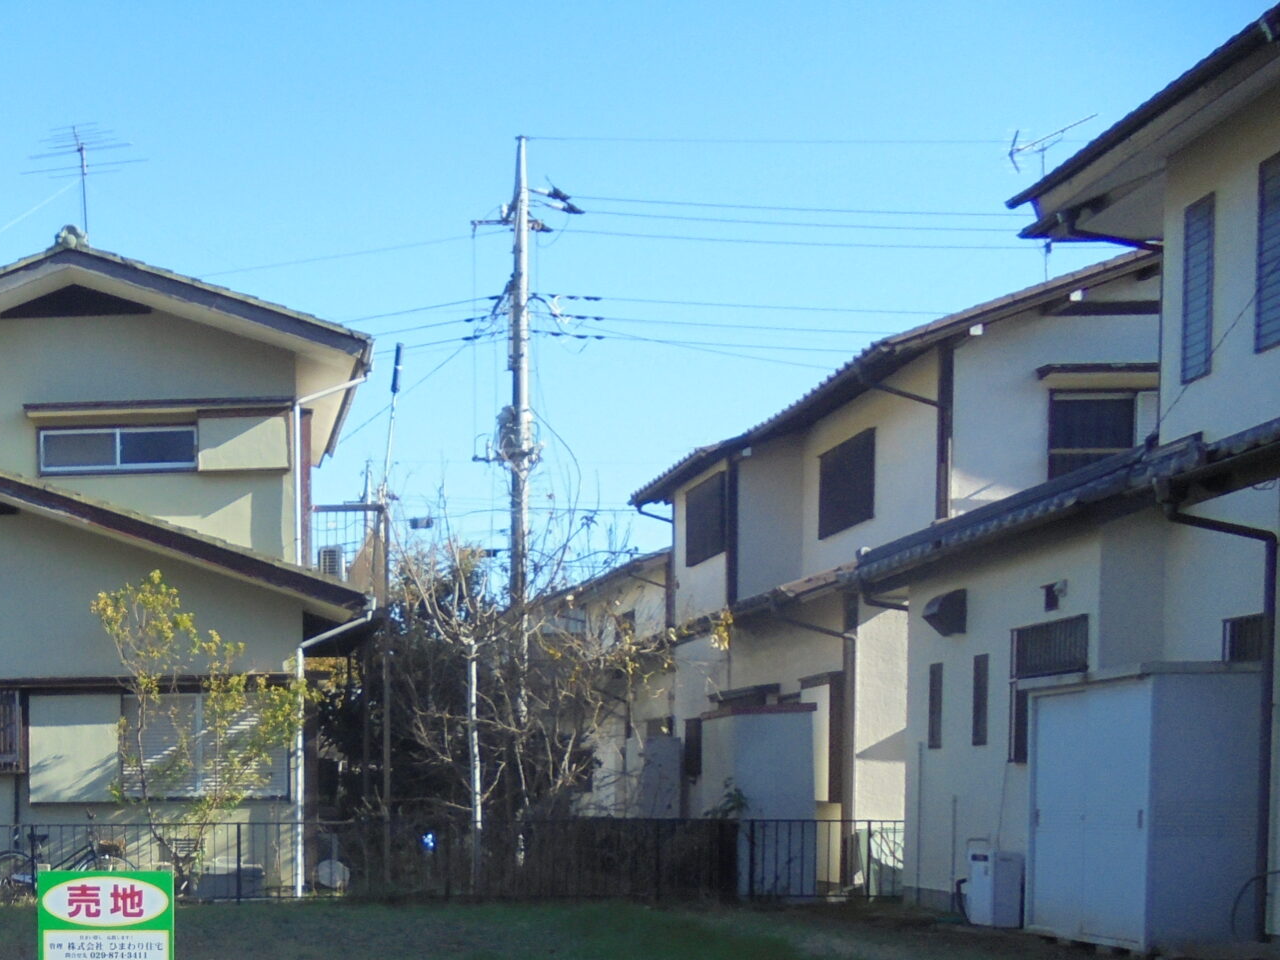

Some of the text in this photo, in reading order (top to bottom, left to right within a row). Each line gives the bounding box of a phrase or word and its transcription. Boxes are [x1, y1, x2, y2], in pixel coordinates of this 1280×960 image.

[67, 884, 144, 918] 売地
[67, 942, 103, 951] 株式会社
